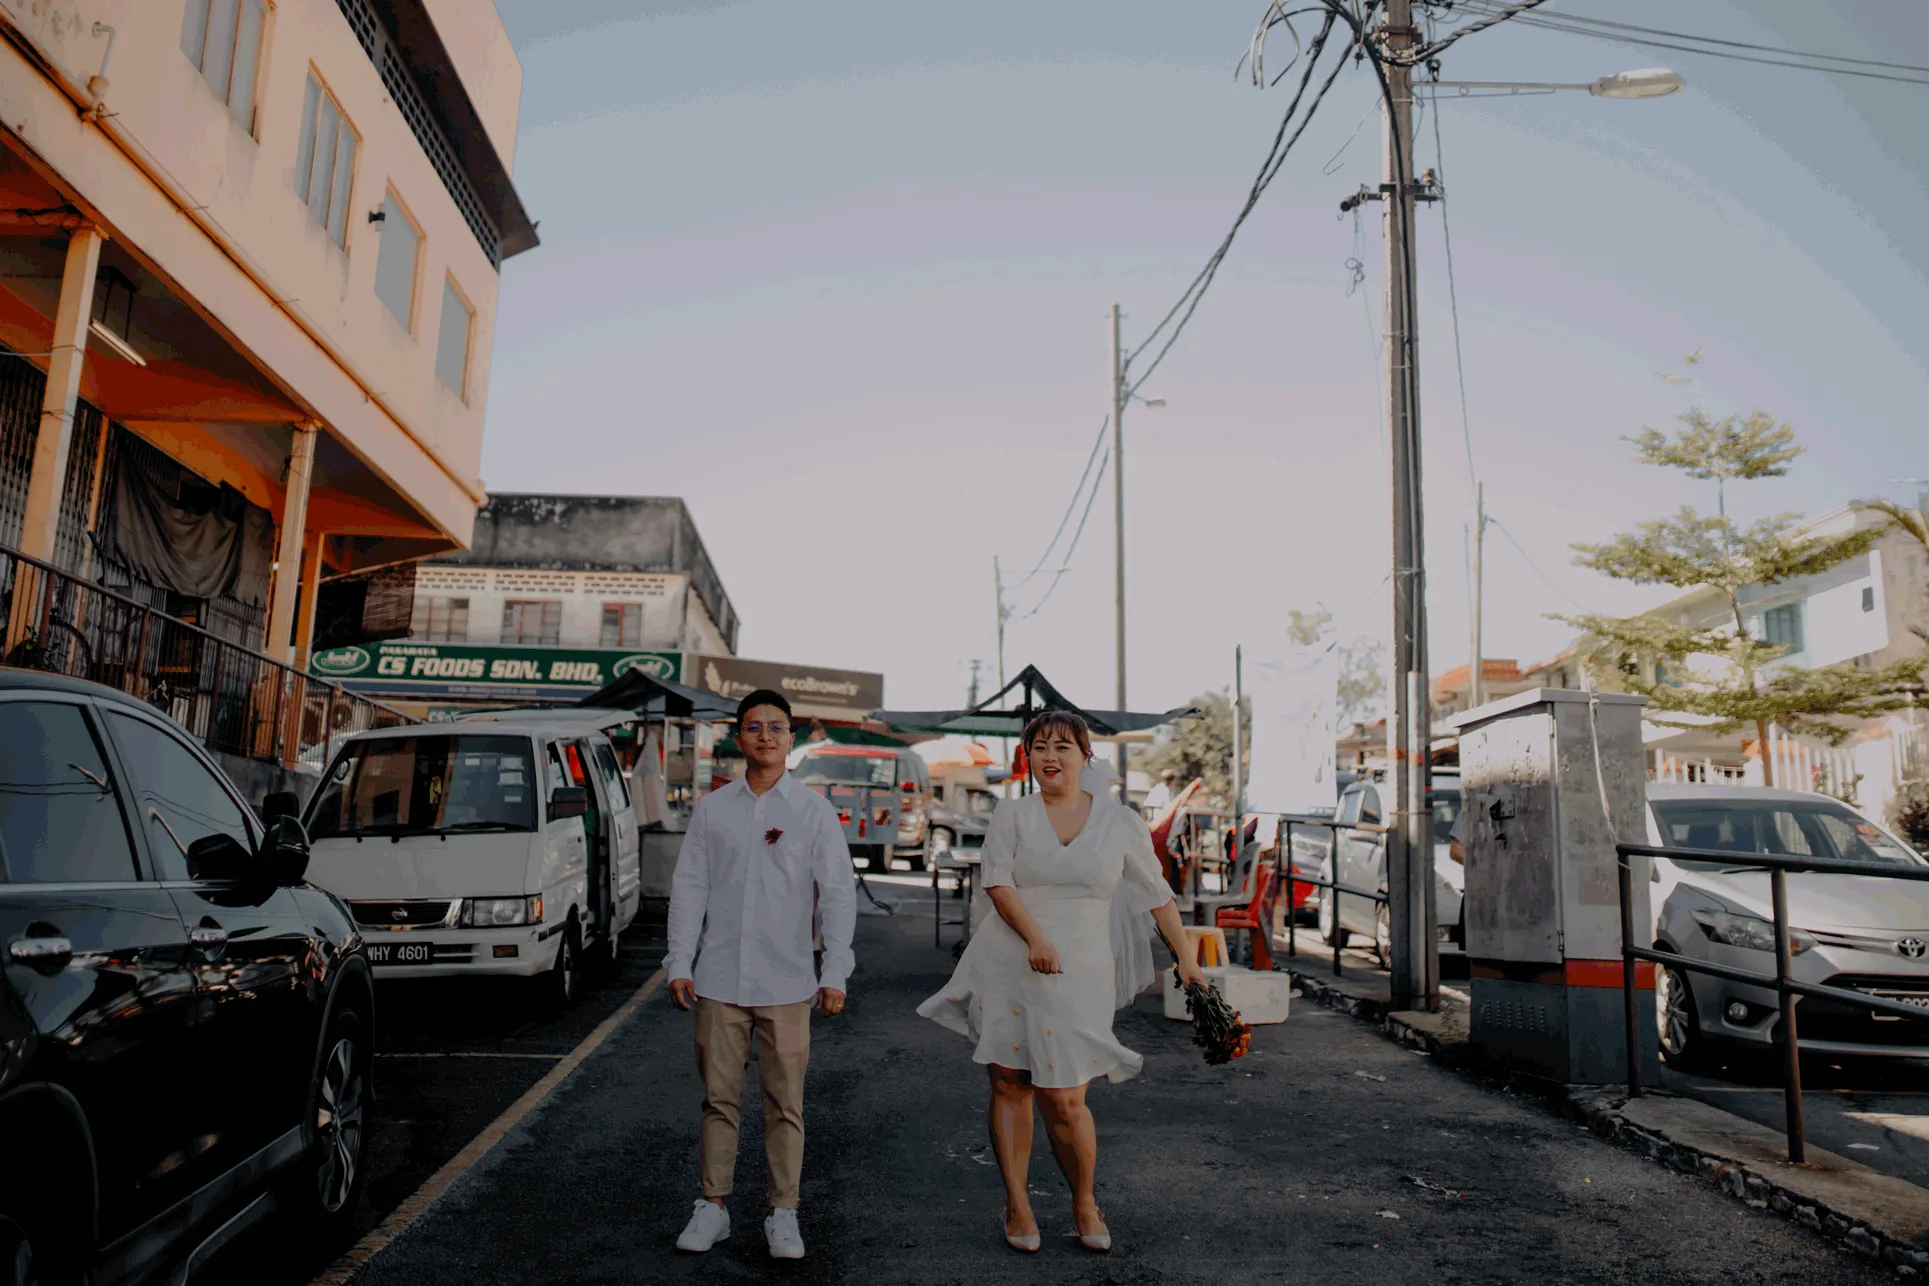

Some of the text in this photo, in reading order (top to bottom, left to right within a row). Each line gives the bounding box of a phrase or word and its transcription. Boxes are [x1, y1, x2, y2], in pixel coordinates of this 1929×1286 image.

[377, 656, 408, 676] CS
[411, 657, 486, 678] FOODS
[489, 659, 543, 680] SDN.
[549, 661, 604, 682] BHD.
[367, 945, 428, 961] WHY 4601
